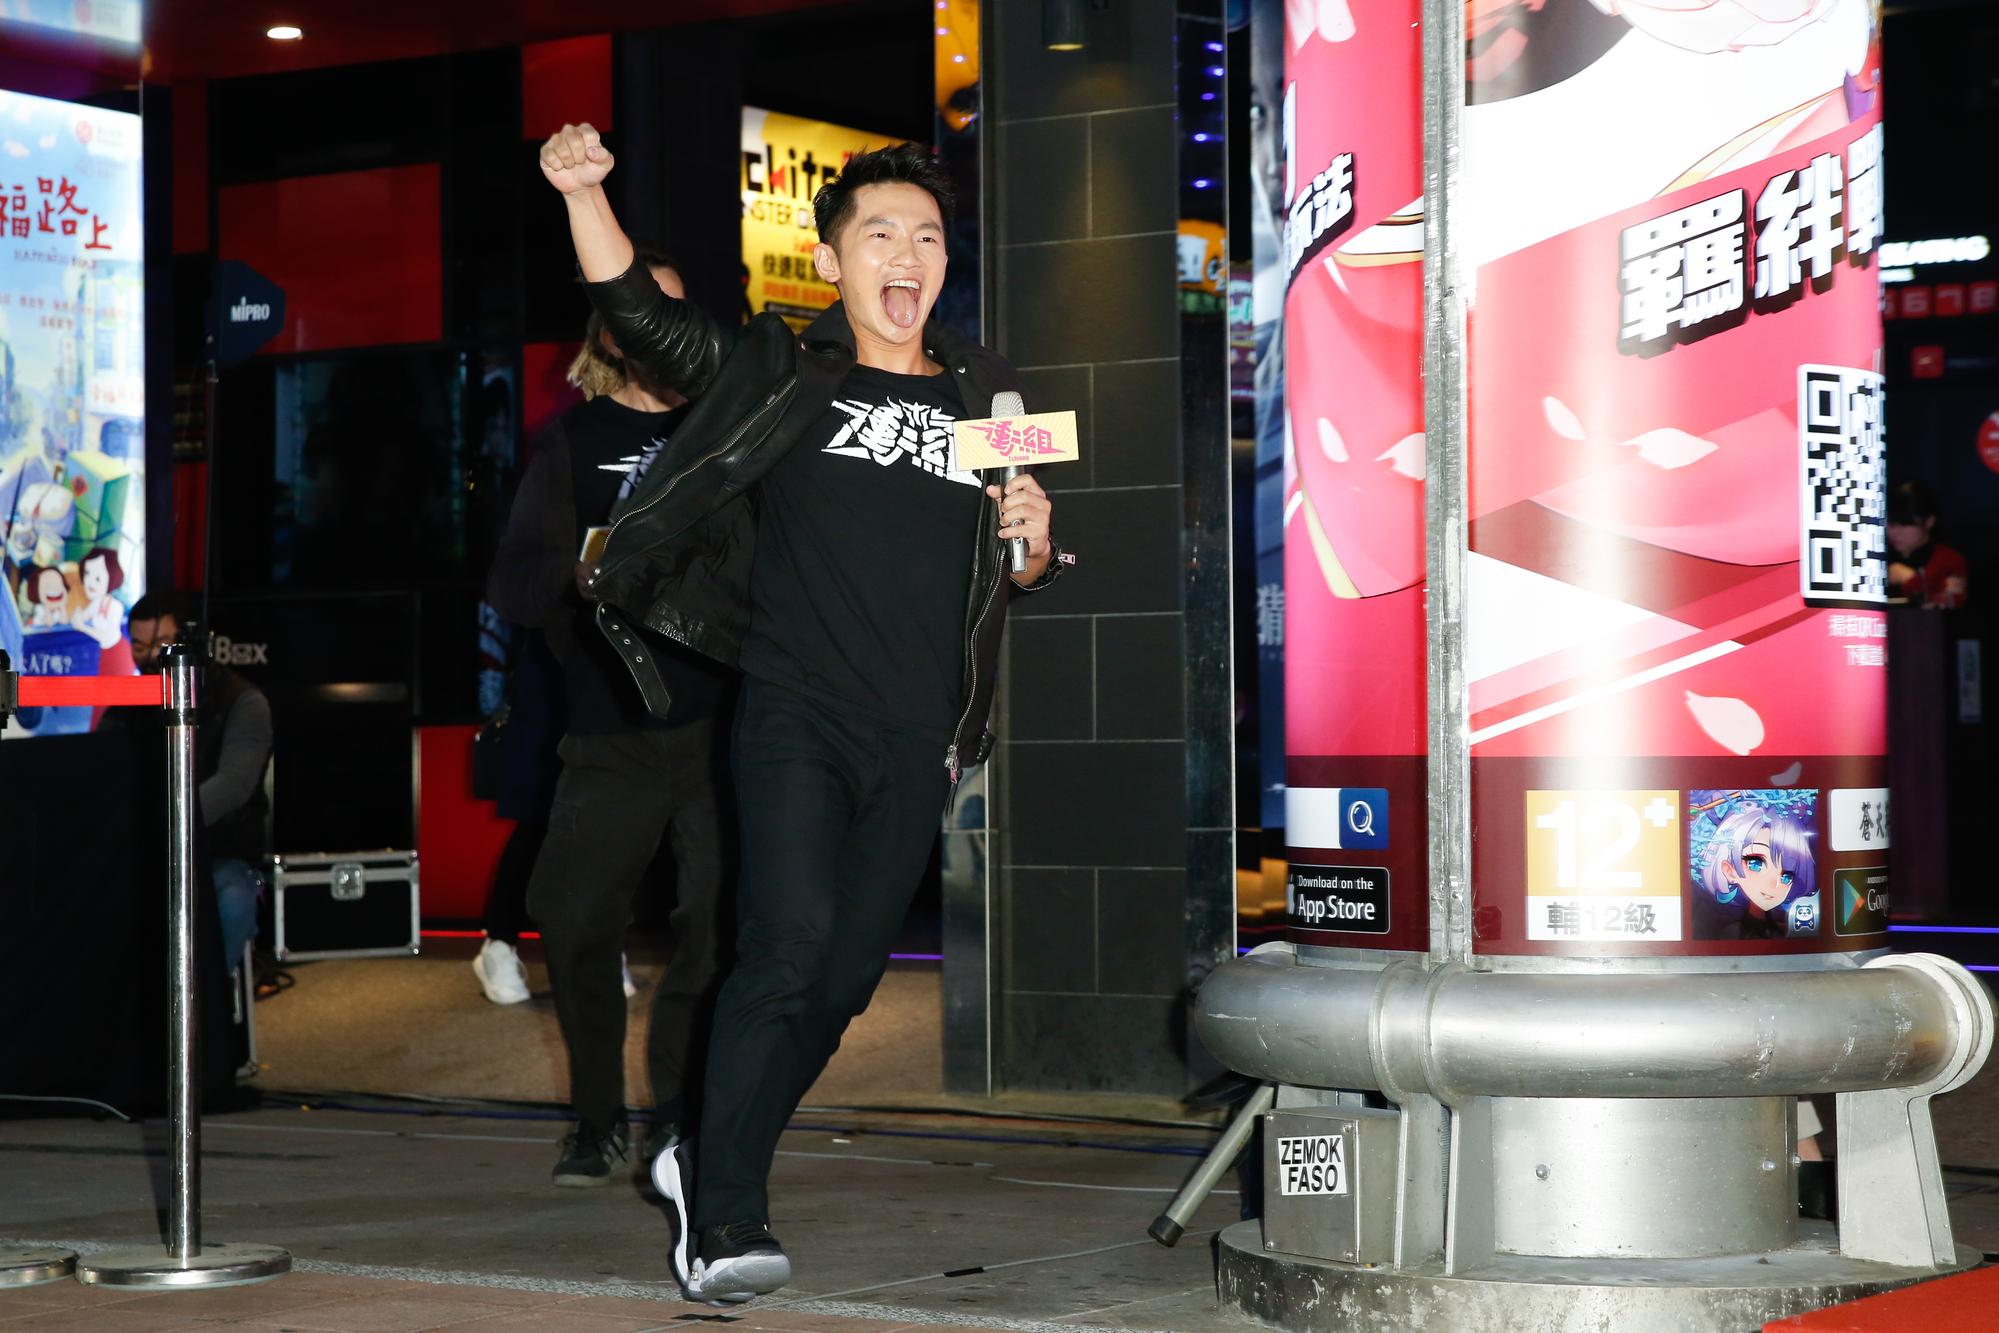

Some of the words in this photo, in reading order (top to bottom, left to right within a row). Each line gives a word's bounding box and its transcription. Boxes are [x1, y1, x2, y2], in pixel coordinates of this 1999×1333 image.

[1297, 874, 1338, 889] Download
[1340, 879, 1354, 889] on
[1356, 876, 1375, 890] the
[1298, 893, 1326, 924] App
[1326, 894, 1376, 921] Store
[1546, 901, 1658, 935] 輔12級
[1281, 1137, 1342, 1165] ZEMOK
[1287, 1164, 1339, 1193] FASO
